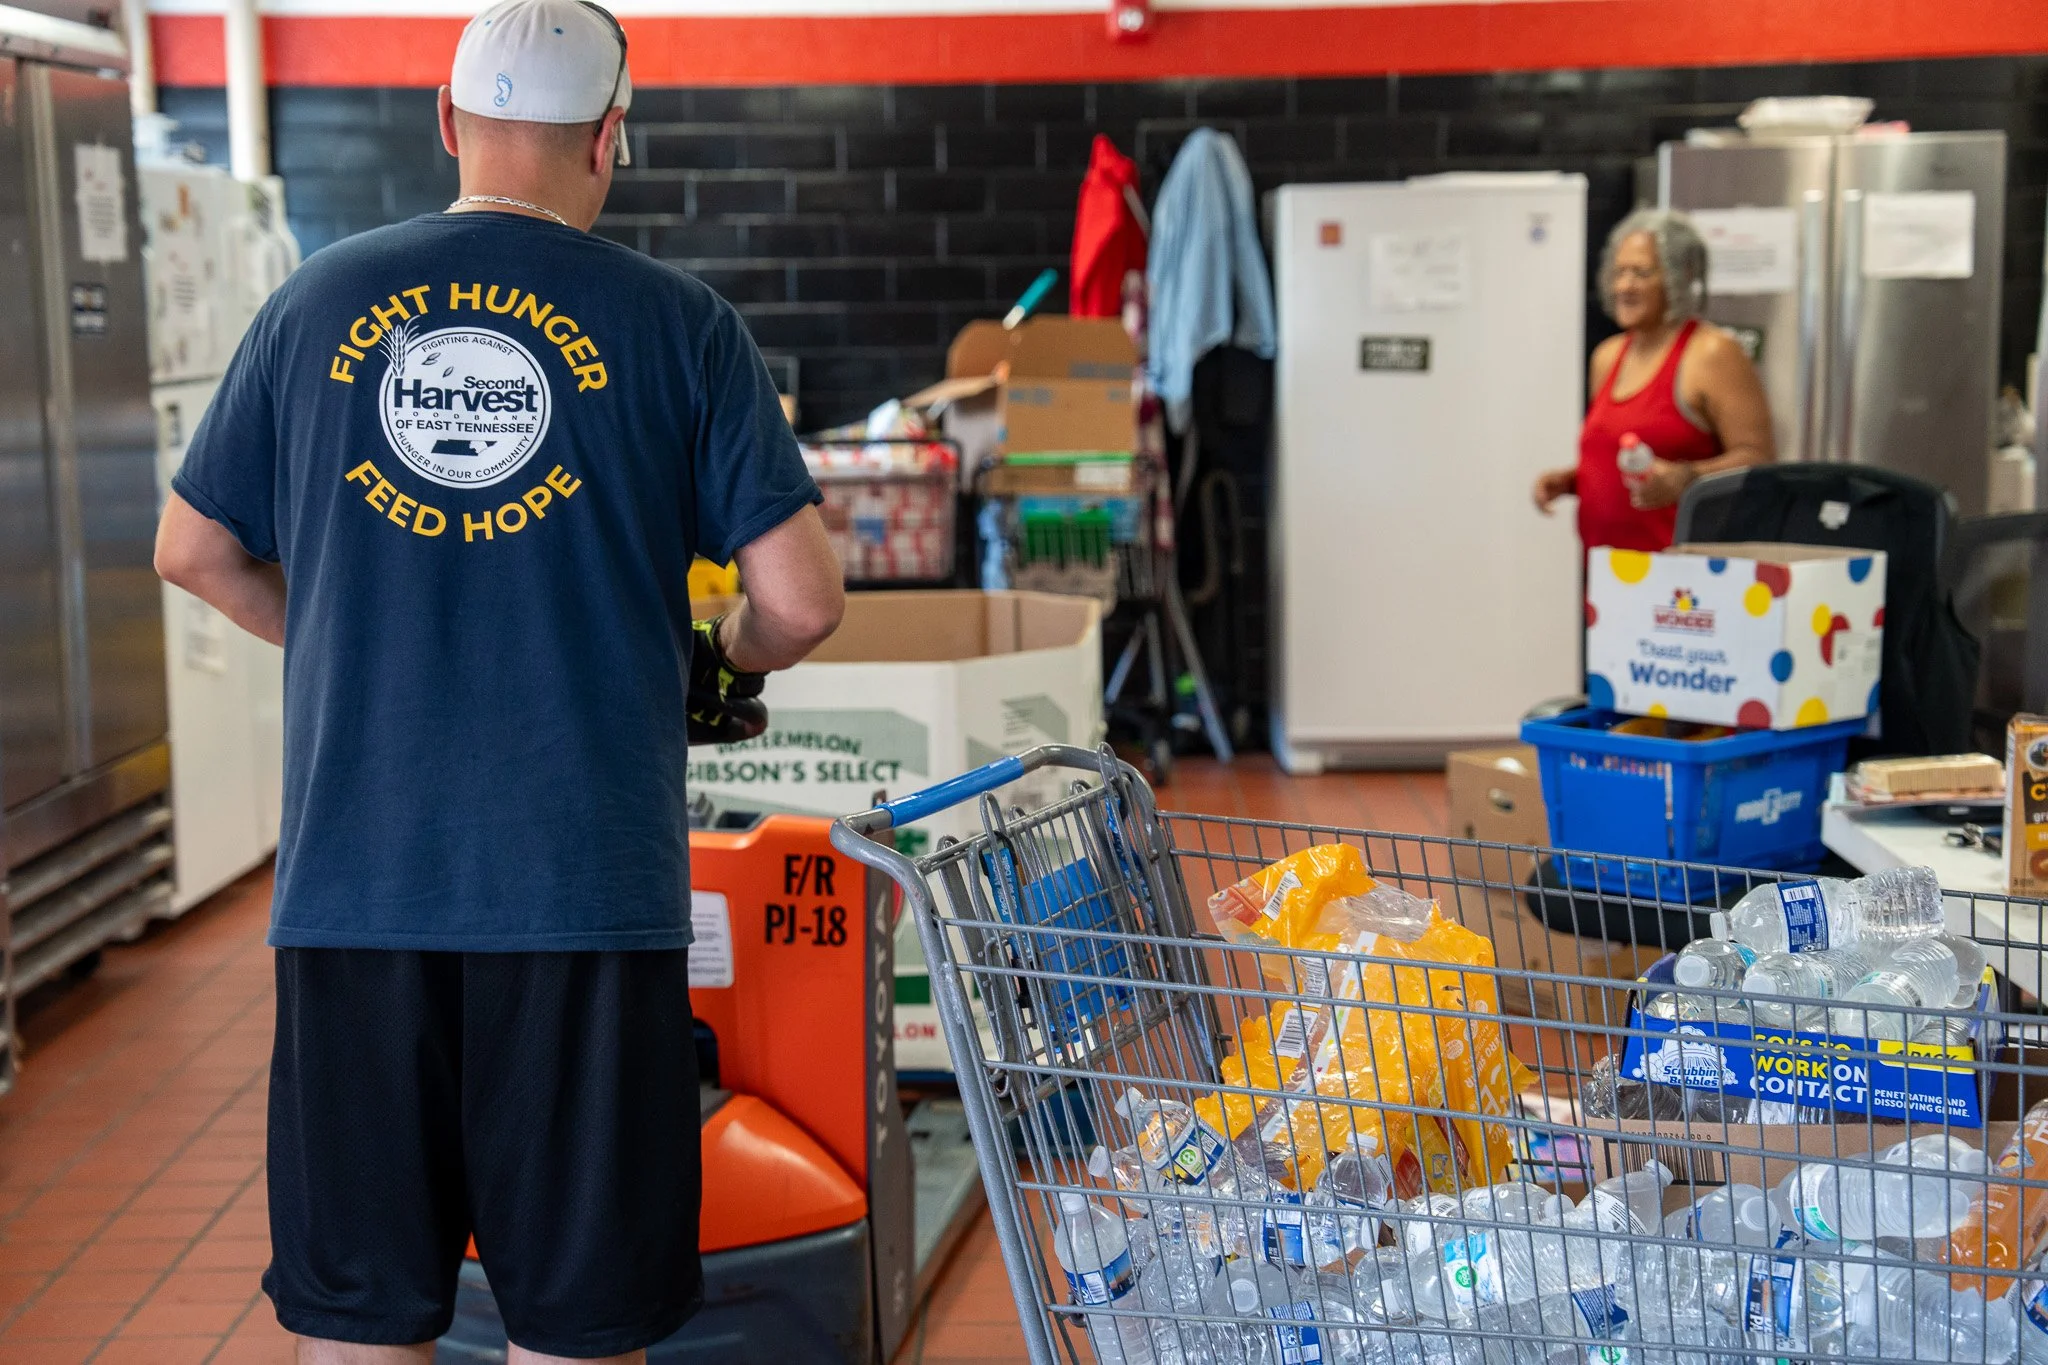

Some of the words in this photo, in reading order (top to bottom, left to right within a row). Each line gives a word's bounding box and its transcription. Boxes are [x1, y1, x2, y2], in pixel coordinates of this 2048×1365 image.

[330, 284, 432, 384] FIGHT
[450, 282, 608, 393] HUNGER
[421, 335, 469, 353] FIGHTING
[472, 336, 514, 356] AGAINST
[394, 377, 538, 413] Harvest
[463, 375, 525, 389] Second
[395, 419, 413, 429] OF
[417, 419, 452, 431] EAST
[455, 421, 534, 434] TENNESSEE
[396, 431, 431, 467] HUNGER
[432, 463, 445, 474] IN
[447, 469, 472, 479] OUR
[476, 435, 530, 478] COMMUNITY
[344, 459, 447, 537] FEED
[463, 464, 582, 542] HOPE
[1628, 660, 1738, 693] Wonder
[817, 760, 901, 782] SELECT
[784, 854, 835, 896] F/R
[765, 904, 847, 947] PJ-18
[874, 891, 889, 1159] TOYOTA
[1750, 1054, 1828, 1079] WORK
[1833, 1064, 1867, 1084] ON
[1749, 1075, 1868, 1104] CONTACT
[1874, 1088, 1942, 1104] PENETRATING
